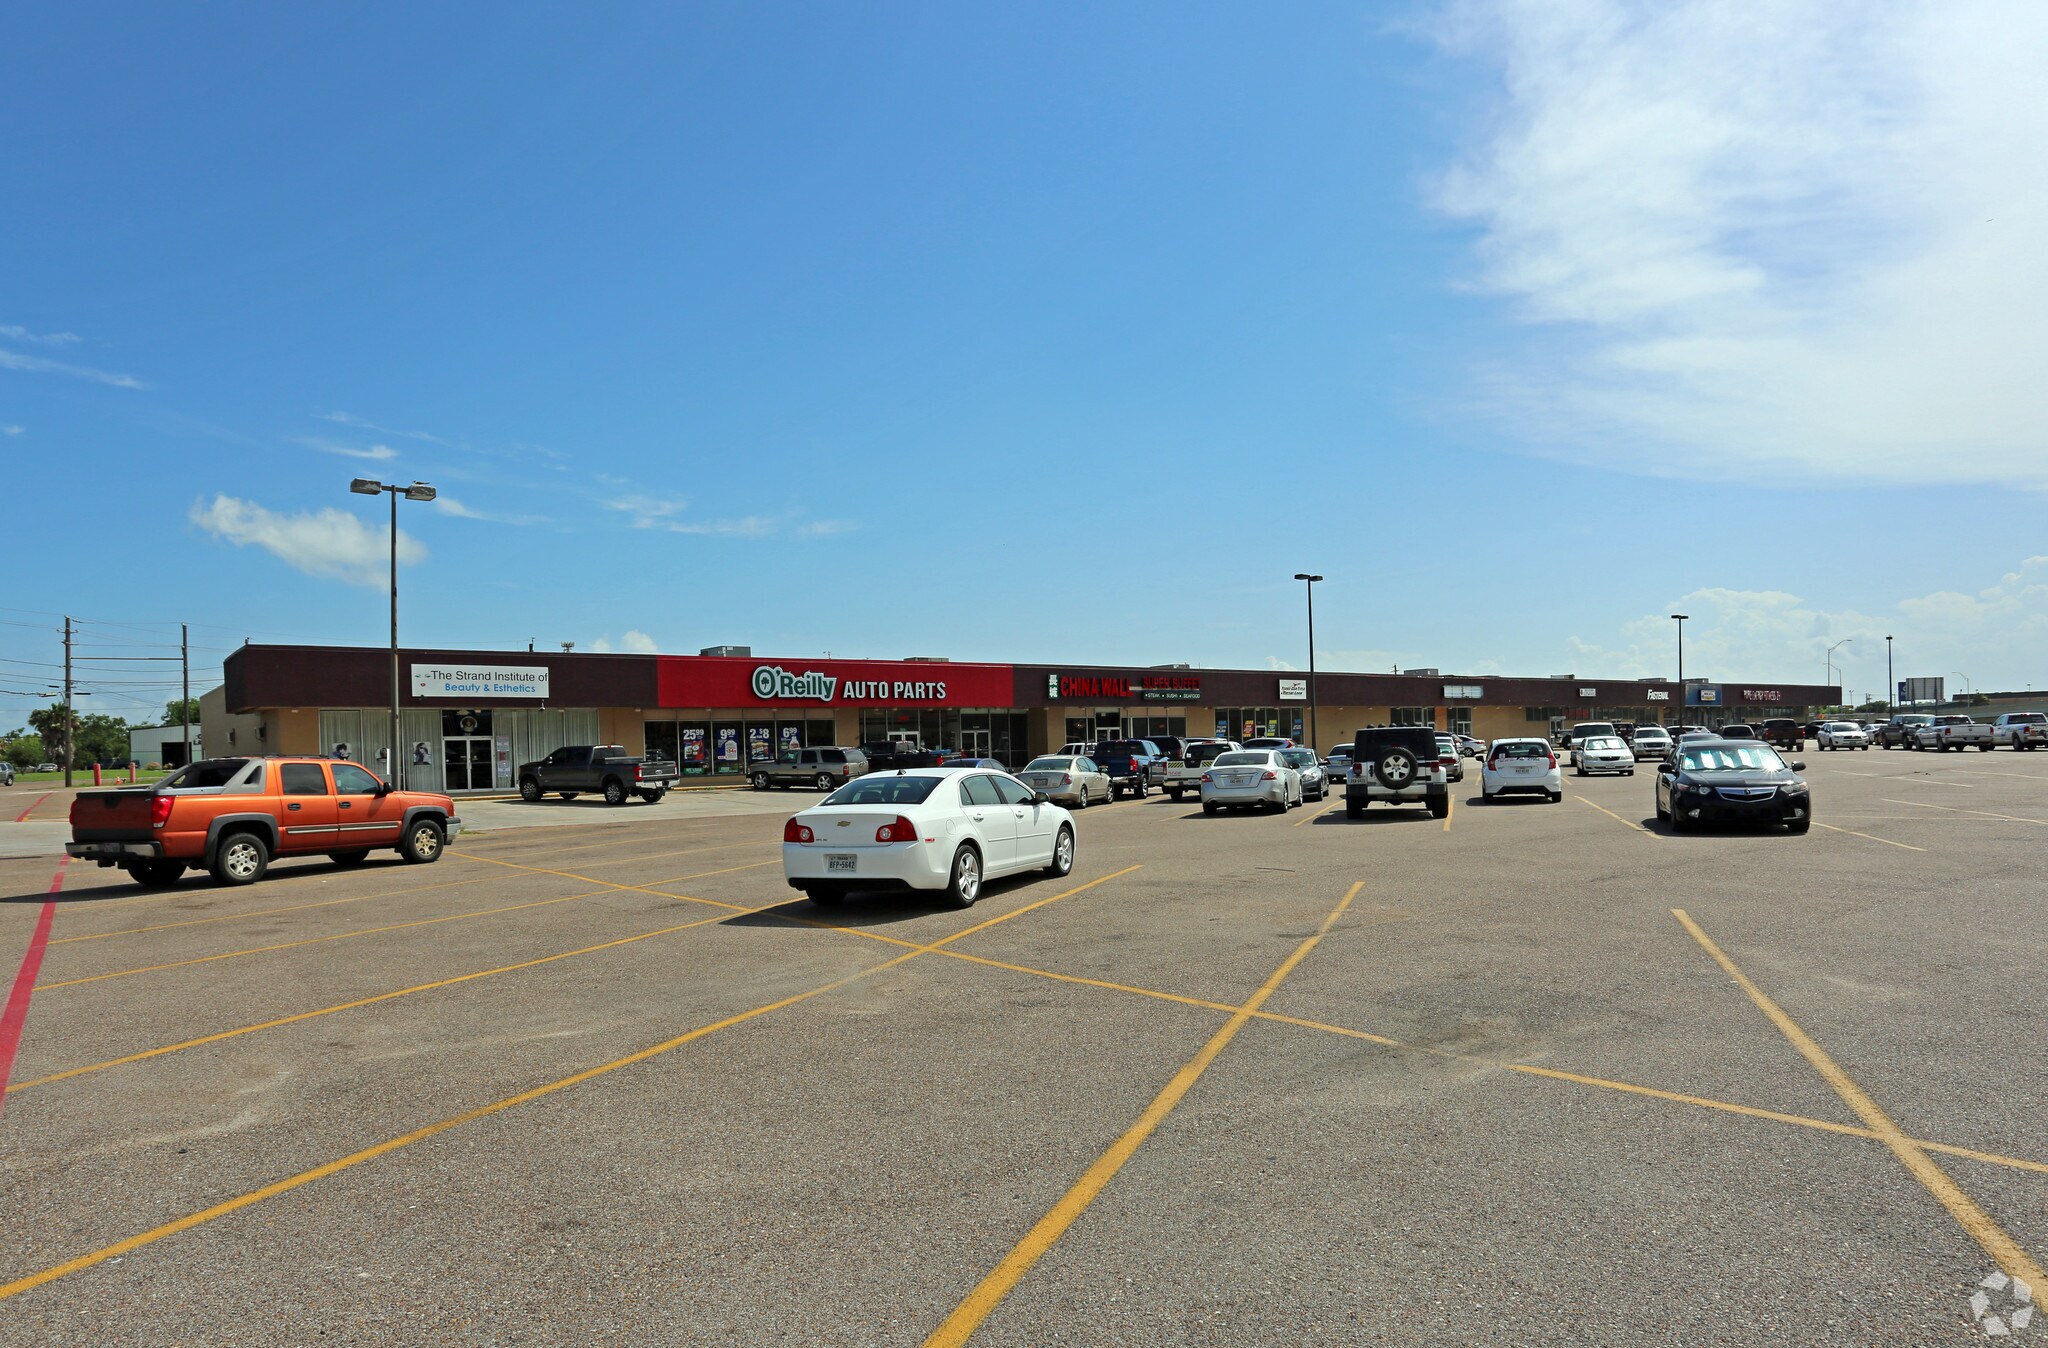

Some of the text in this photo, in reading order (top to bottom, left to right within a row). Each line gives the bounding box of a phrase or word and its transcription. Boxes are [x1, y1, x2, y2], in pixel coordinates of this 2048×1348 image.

[430, 670, 548, 682] The Strand Institute of
[444, 683, 536, 693] Beauty & Esthetics
[753, 667, 947, 700] O'Reilly AUTO PARTS
[1060, 676, 1134, 697] CHINA WALL
[1143, 677, 1201, 690] SUPER BUFFET
